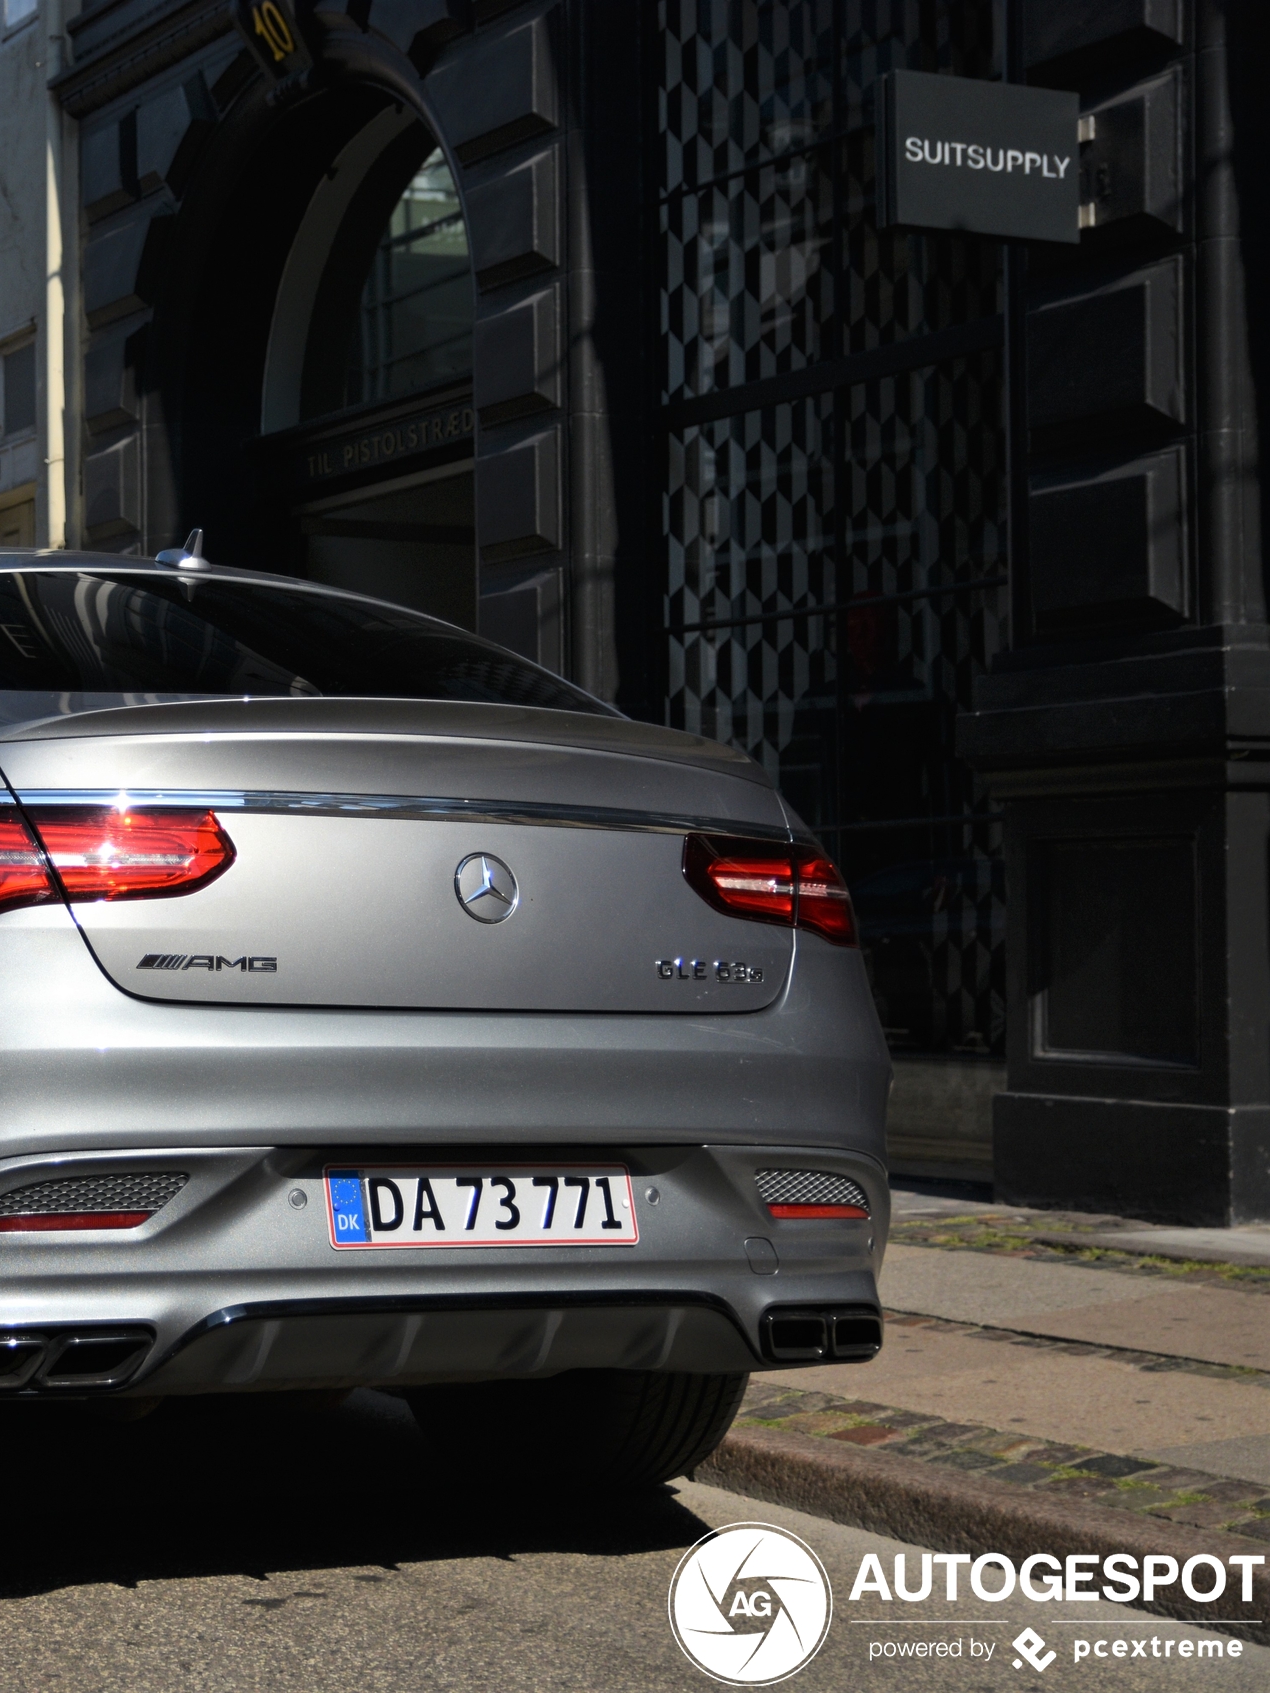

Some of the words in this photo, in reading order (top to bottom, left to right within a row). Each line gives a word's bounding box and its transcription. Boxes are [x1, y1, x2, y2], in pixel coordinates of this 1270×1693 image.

[252, 0, 295, 62] 10
[905, 136, 1070, 179] SUITSUPPLY
[307, 453, 332, 478] TIL
[182, 955, 277, 972] AMG
[655, 958, 707, 980] GLE
[368, 1177, 445, 1231] DA
[455, 1177, 521, 1230] 73
[532, 1176, 623, 1229] 771
[338, 1214, 359, 1231] DK
